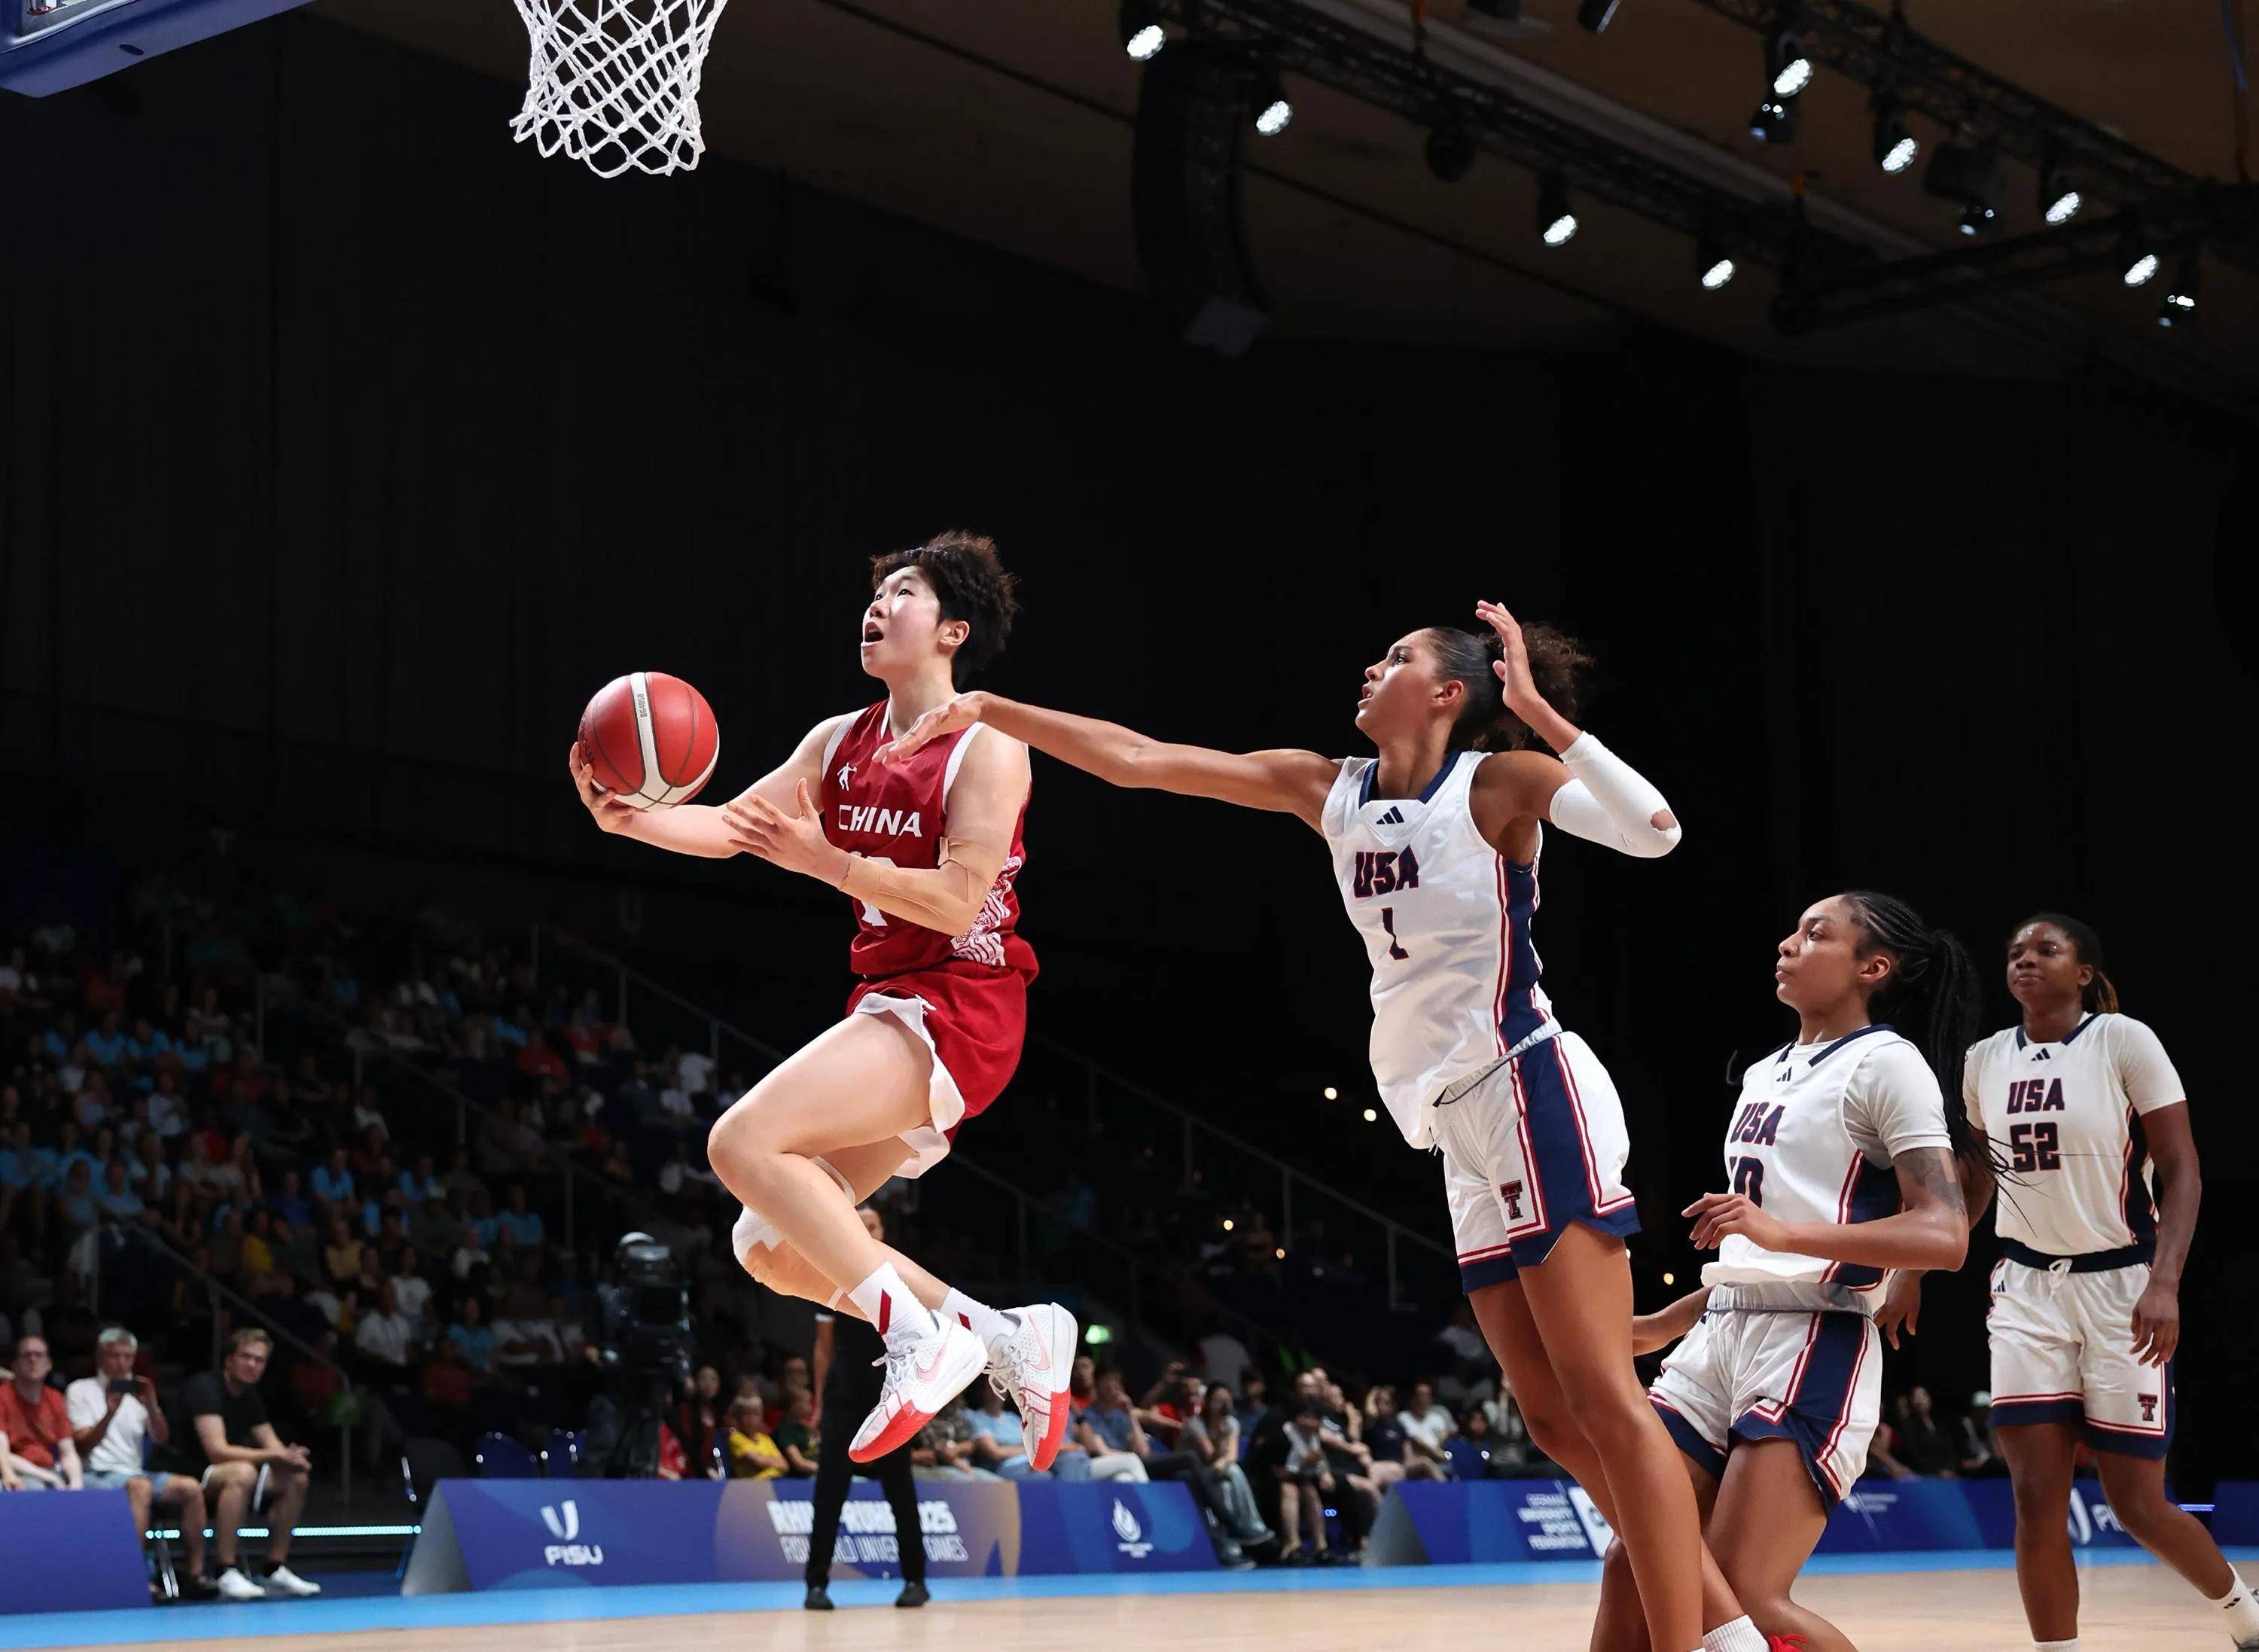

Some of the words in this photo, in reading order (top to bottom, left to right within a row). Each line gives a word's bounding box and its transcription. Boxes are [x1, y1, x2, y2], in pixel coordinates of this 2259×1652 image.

[839, 804, 922, 837] CHINA
[1353, 844, 1419, 898] USA
[1381, 907, 1410, 960] 1
[2007, 1077, 2065, 1114] USA
[1730, 1102, 1786, 1147] USA
[2010, 1122, 2061, 1173] 52
[544, 1544, 604, 1566] FISU
